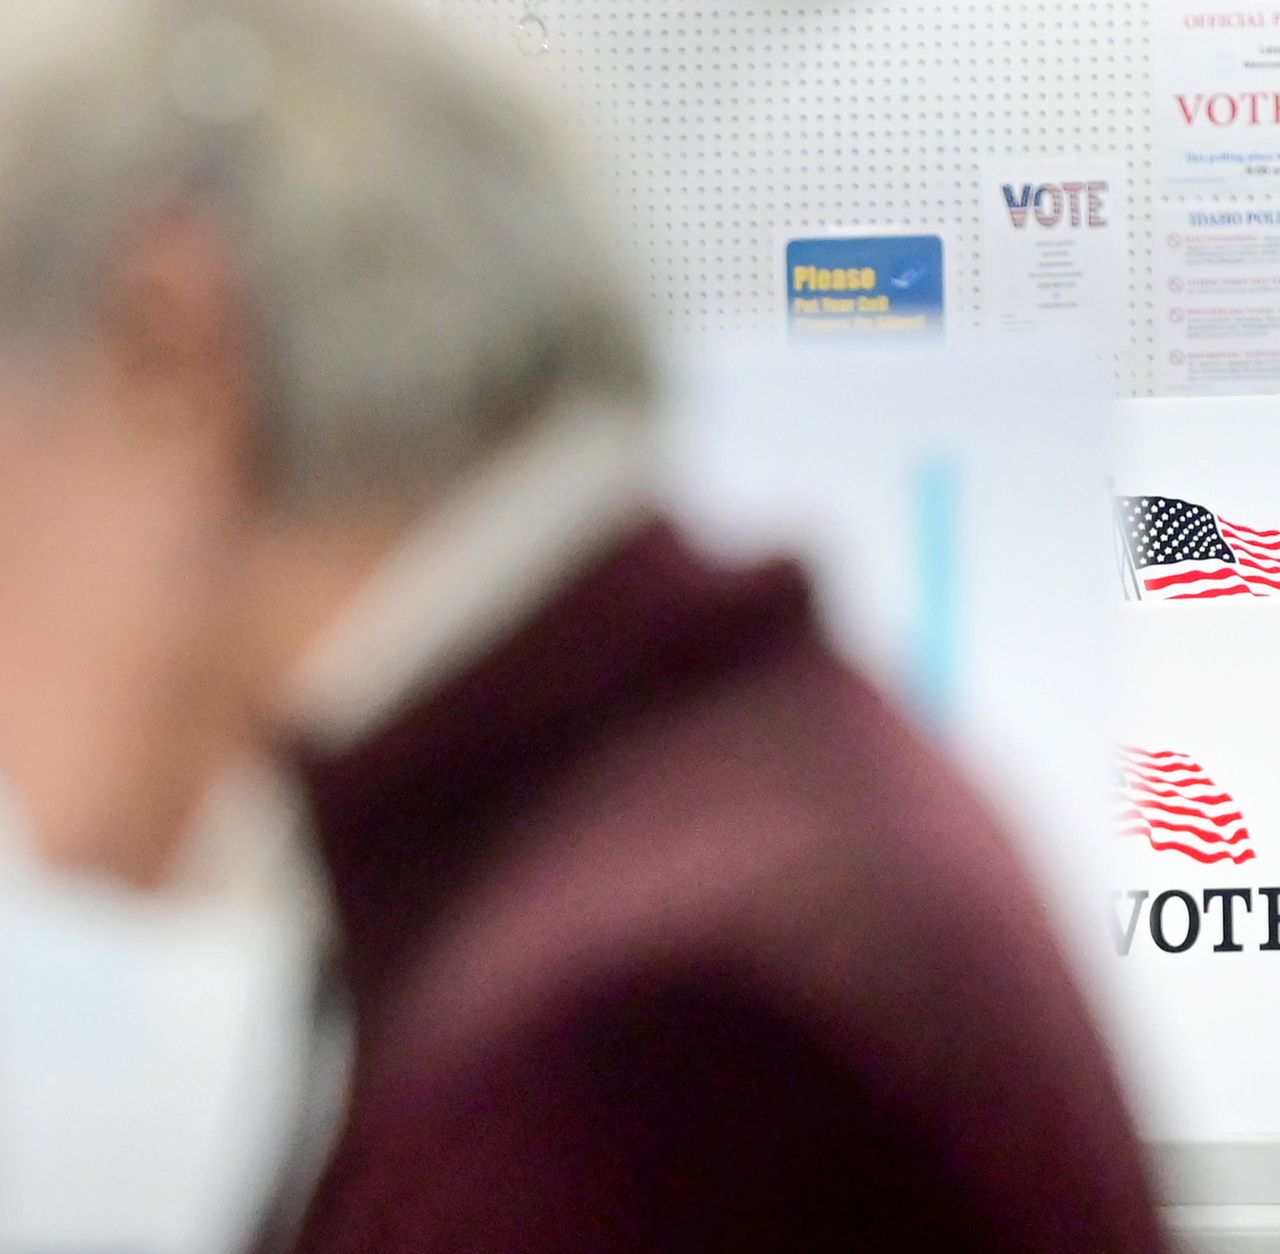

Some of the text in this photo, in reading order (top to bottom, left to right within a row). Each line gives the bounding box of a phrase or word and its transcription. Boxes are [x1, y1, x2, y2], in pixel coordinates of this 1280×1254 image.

[1183, 13, 1265, 29] OFFICIAL
[1002, 181, 1109, 228] VOTE
[1189, 212, 1243, 227] IDAHO
[793, 265, 877, 291] Please
